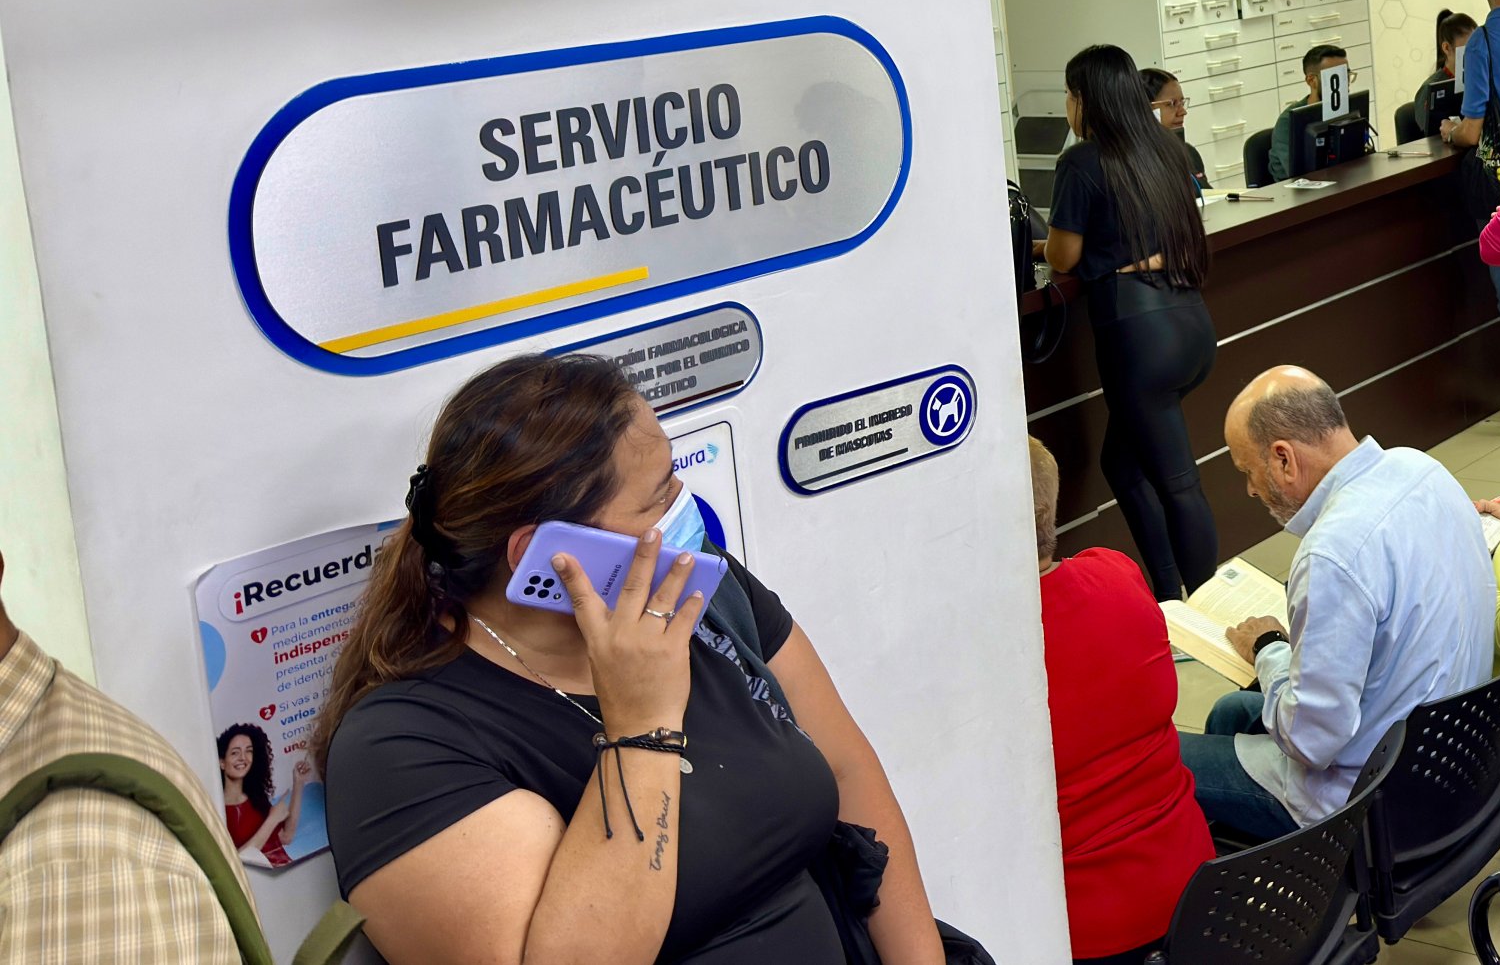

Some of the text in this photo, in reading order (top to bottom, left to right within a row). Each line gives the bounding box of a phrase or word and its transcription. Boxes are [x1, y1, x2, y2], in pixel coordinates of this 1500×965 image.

[1330, 73, 1341, 112] 8
[478, 82, 742, 182] SERVICIO
[376, 140, 832, 289] FARMACÉUTICO
[647, 320, 748, 360] FARMACOLOGICA
[656, 358, 682, 378] POR
[683, 354, 699, 370] EL
[794, 403, 913, 451] PROHIBIDO EL INGRESO
[672, 449, 705, 472] sura
[818, 428, 893, 462] DE MASCOTAS
[233, 544, 380, 615] ¡Recuerd
[602, 563, 623, 596] SAMSUNG
[271, 621, 296, 636] Para
[299, 617, 309, 626] la
[274, 630, 349, 665] indispens
[276, 653, 328, 681] presentar
[276, 665, 333, 693] de identid
[278, 702, 289, 713] Si
[291, 696, 311, 707] vas
[312, 692, 320, 700] a
[280, 706, 317, 726] varios
